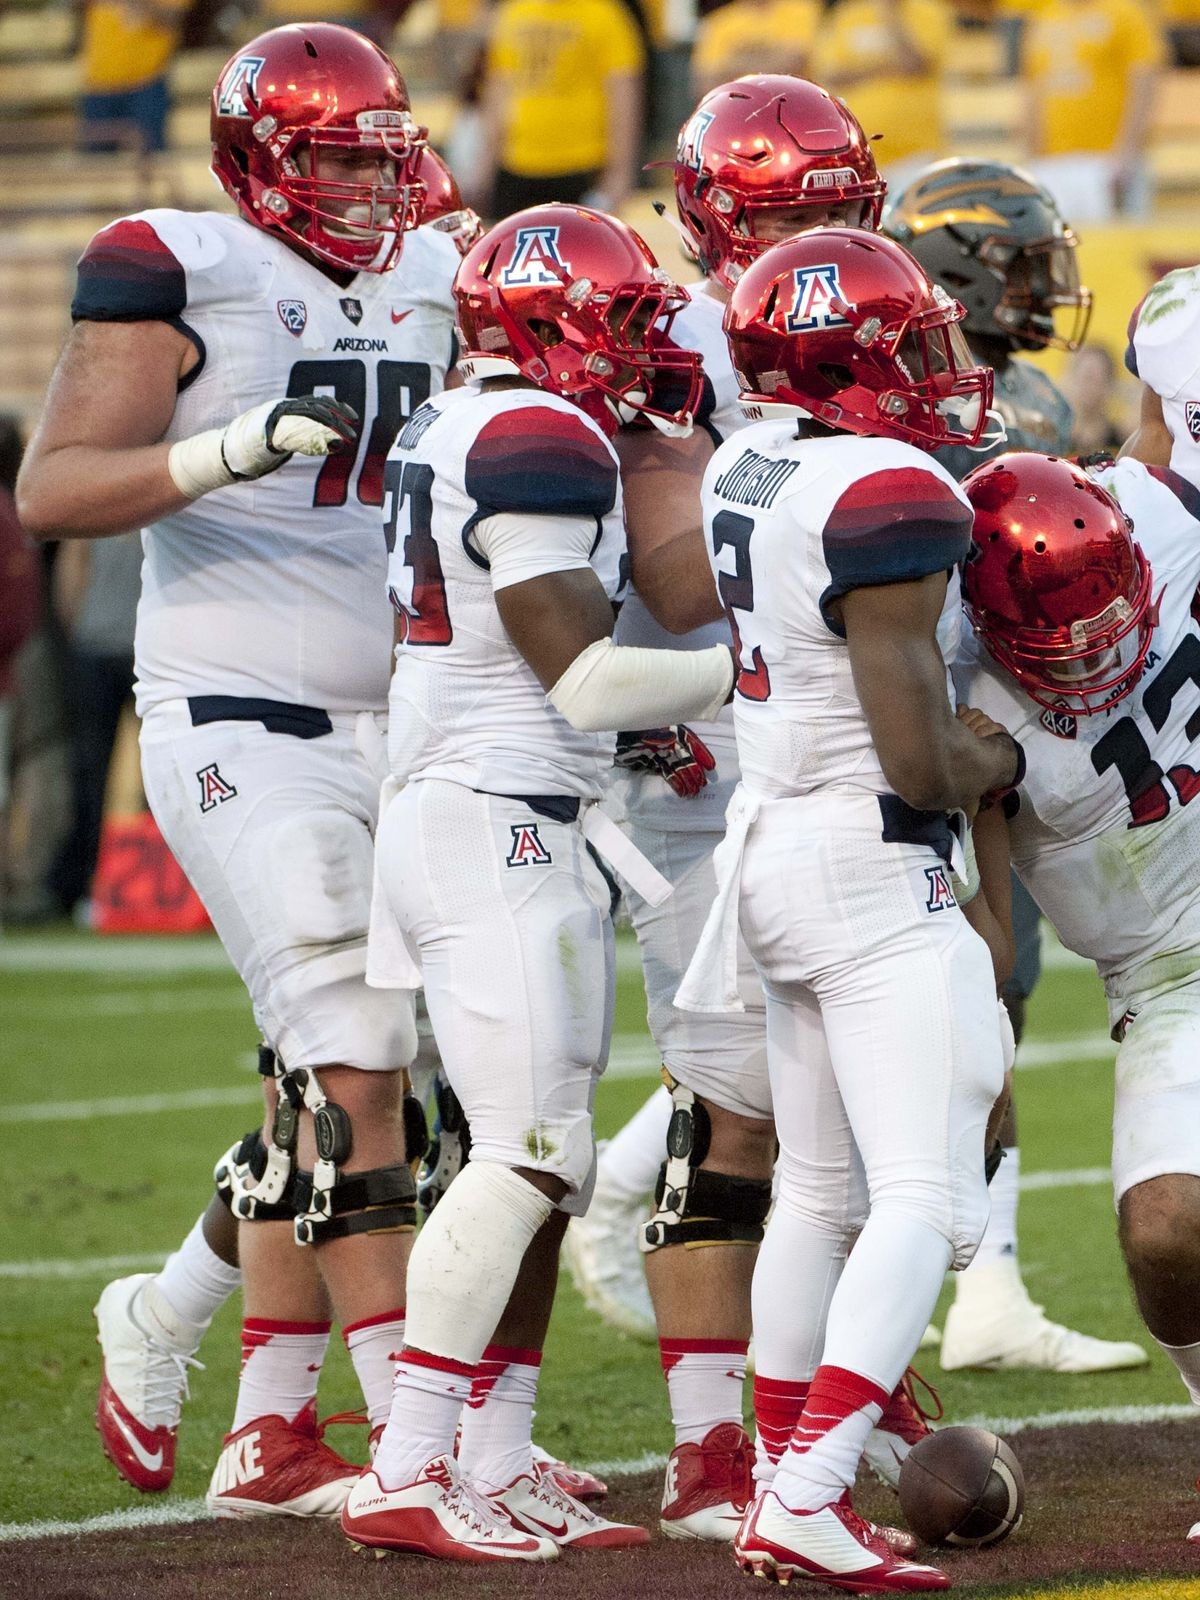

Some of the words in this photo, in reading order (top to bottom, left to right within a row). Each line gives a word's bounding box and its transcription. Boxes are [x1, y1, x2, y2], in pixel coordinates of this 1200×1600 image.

[217, 56, 266, 119] A
[812, 173, 834, 188] HARD
[834, 171, 852, 186] EDGE
[502, 227, 571, 287] A
[279, 301, 306, 321] PAC
[785, 263, 857, 335] A
[287, 315, 303, 329] 12
[333, 337, 389, 352] ARIZONA
[196, 762, 238, 814] A
[506, 823, 552, 868] A
[924, 865, 957, 913] A
[353, 1495, 388, 1511] ALPHA
